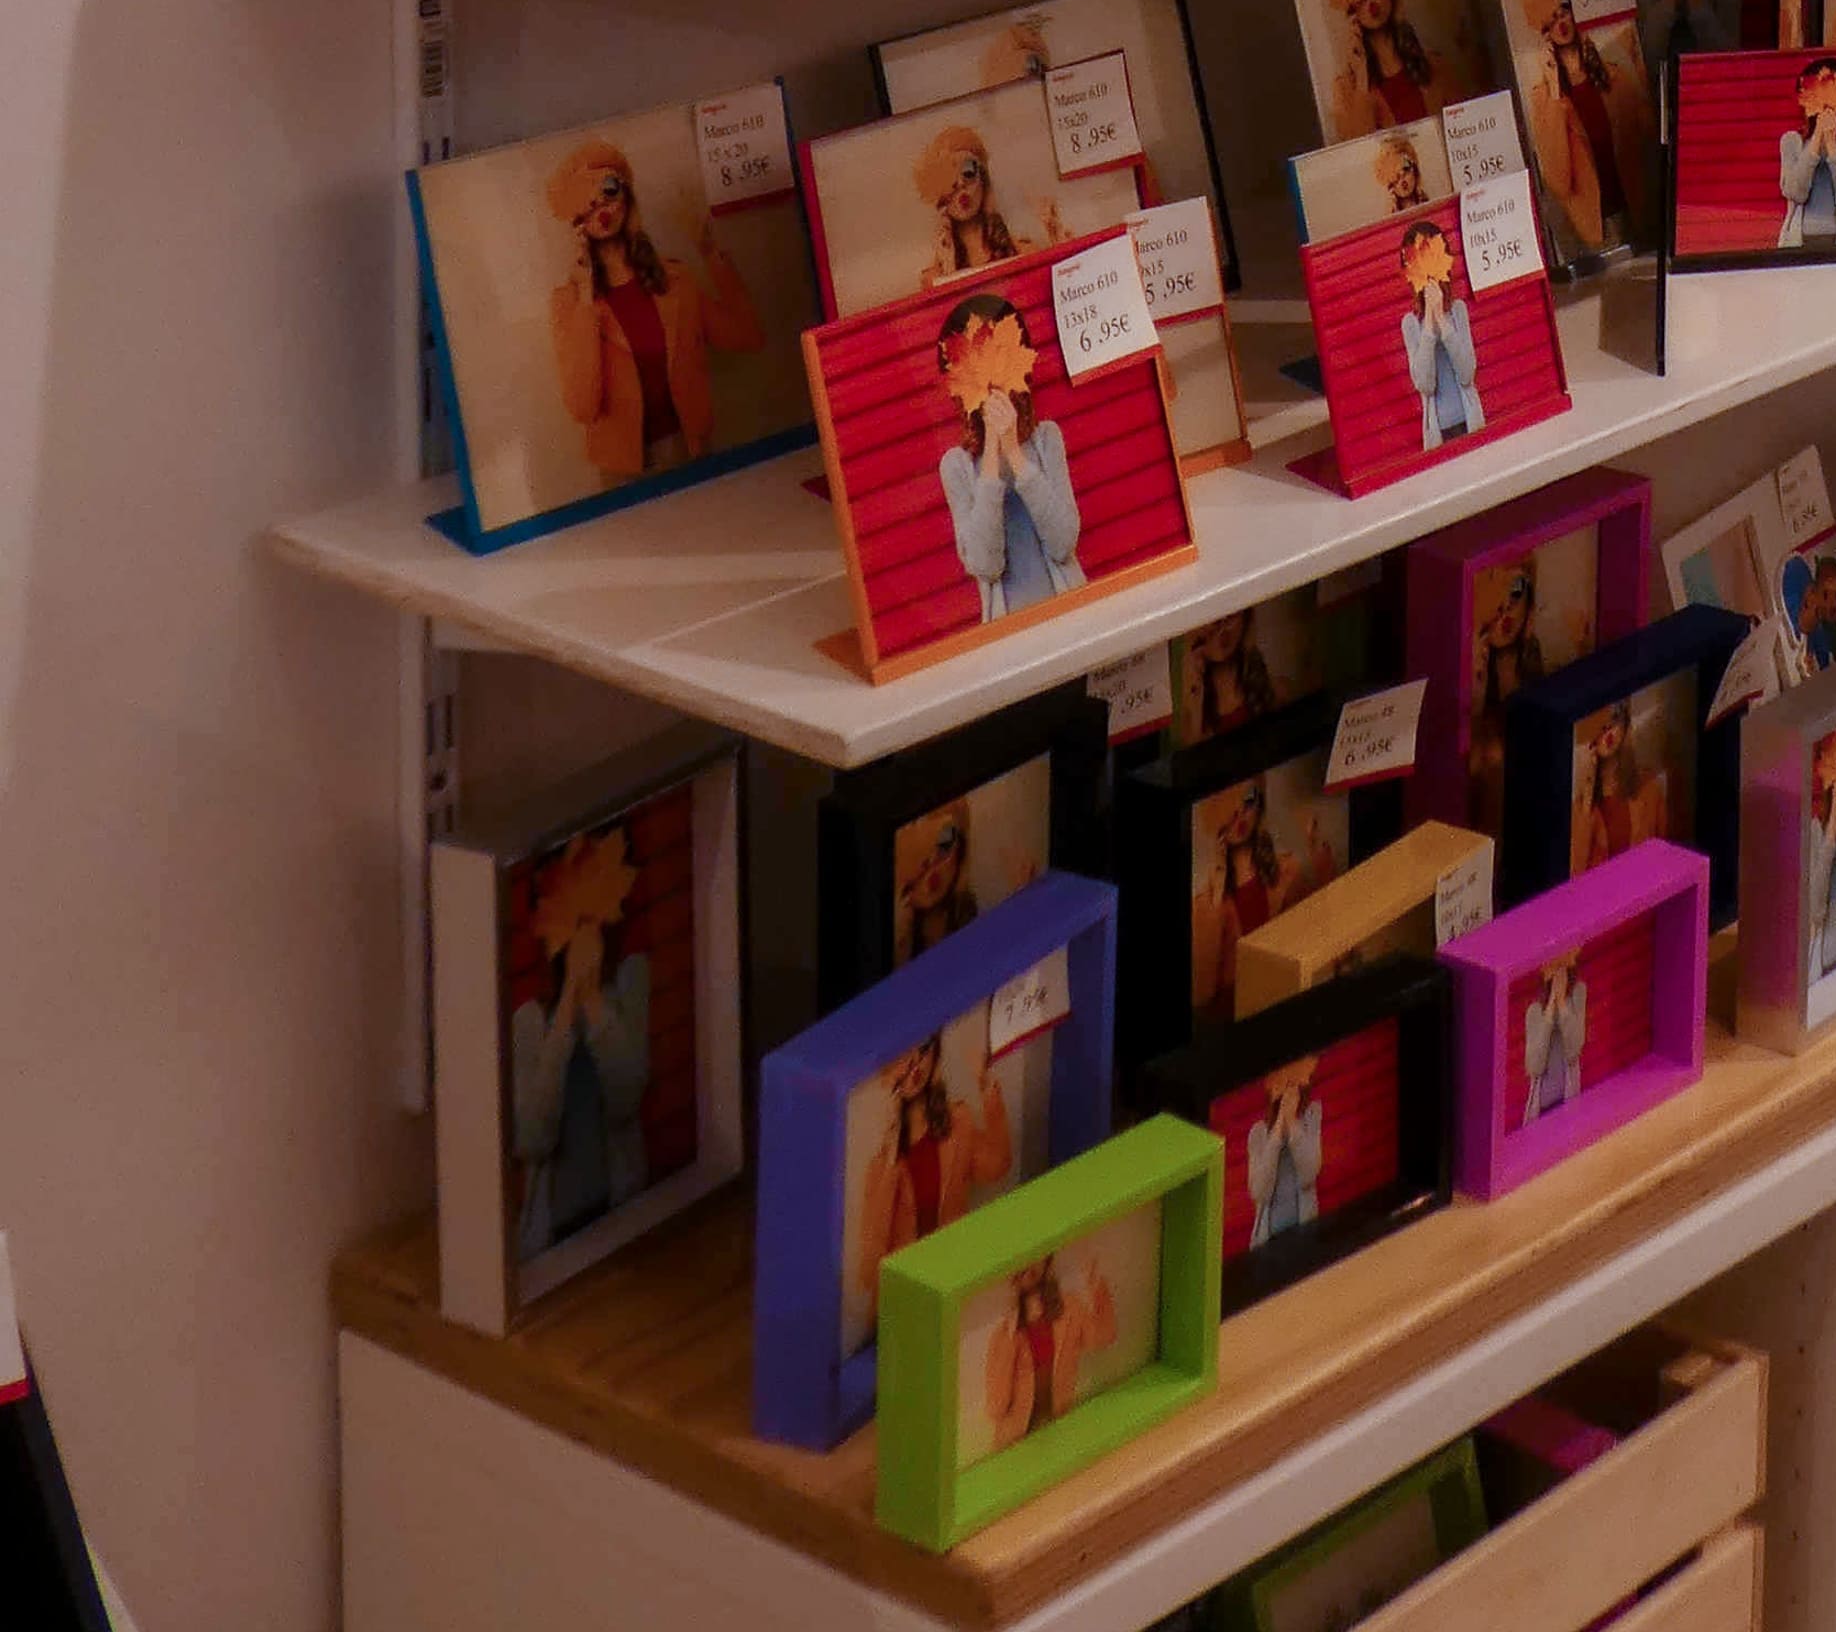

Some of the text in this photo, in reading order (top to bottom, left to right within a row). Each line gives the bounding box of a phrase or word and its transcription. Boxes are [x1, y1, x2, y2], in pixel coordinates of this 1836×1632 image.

[1054, 91, 1088, 105] Marco
[1447, 117, 1496, 140] Marco 610
[1466, 200, 1515, 224] Marco 610
[1165, 230, 1188, 247] 610
[1059, 270, 1119, 304] Marco 610
[1064, 304, 1098, 330] 13x18
